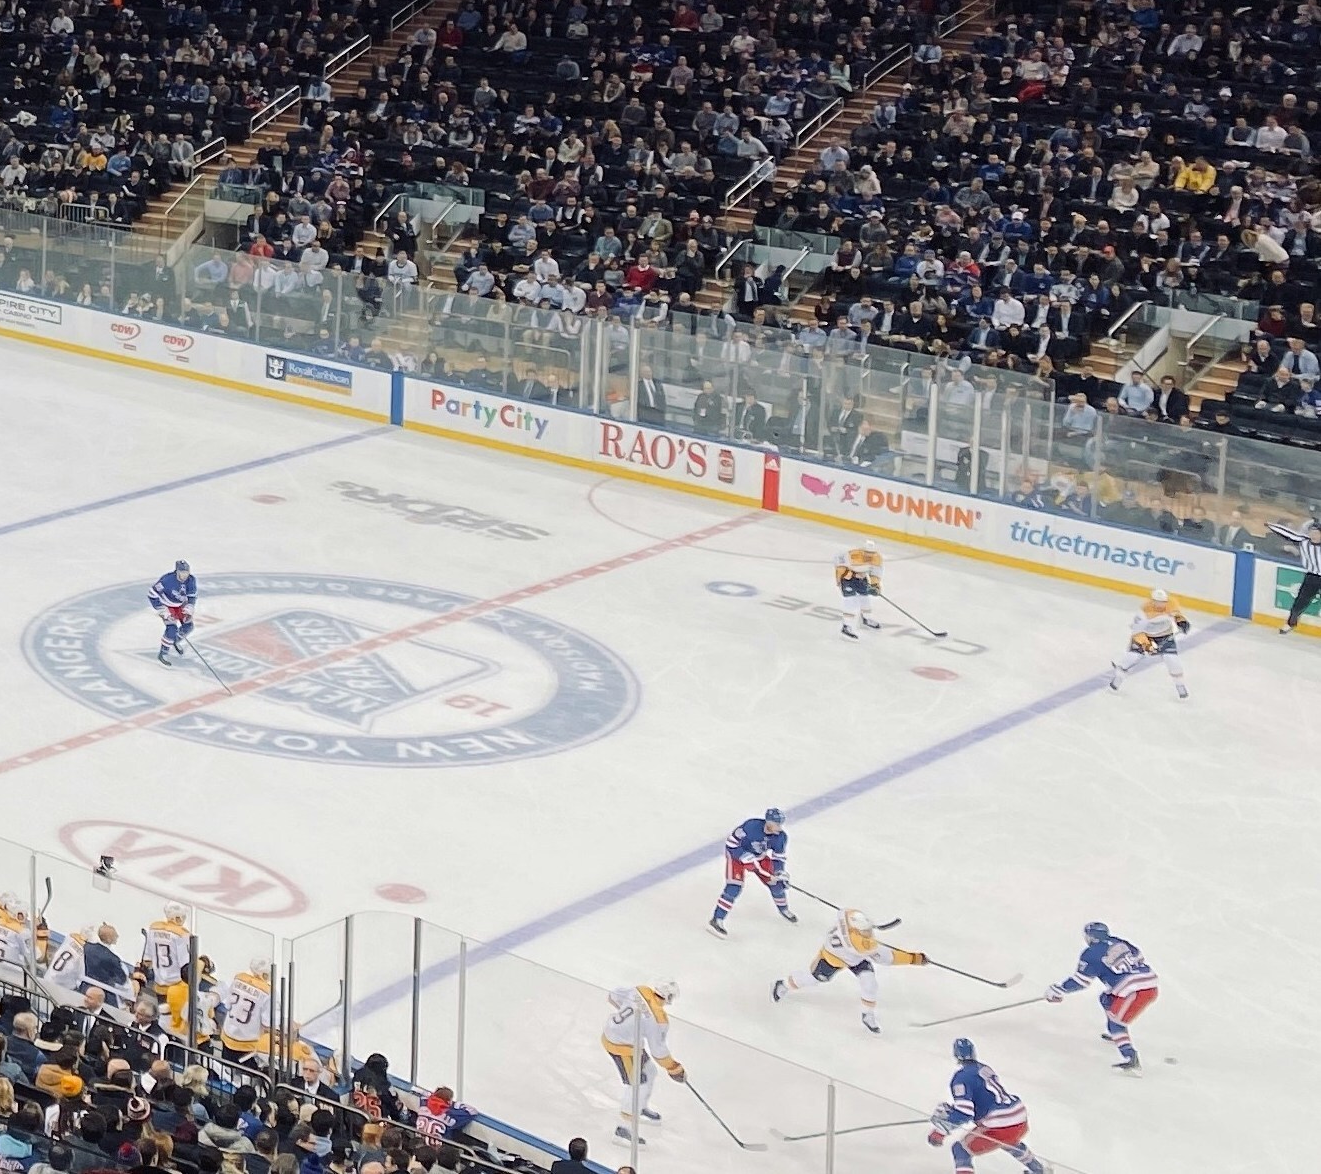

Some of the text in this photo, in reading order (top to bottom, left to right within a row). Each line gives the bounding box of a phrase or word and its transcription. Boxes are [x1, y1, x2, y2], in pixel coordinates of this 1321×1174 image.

[27, 305, 57, 318] CITY
[110, 322, 135, 337] CDW
[162, 334, 188, 348] CDW
[598, 421, 708, 478] RAO'S
[1009, 520, 1186, 577] ticketmaster
[41, 614, 149, 716] RANGERS
[190, 716, 538, 760] YORK NEW
[103, 828, 279, 907] KIA
